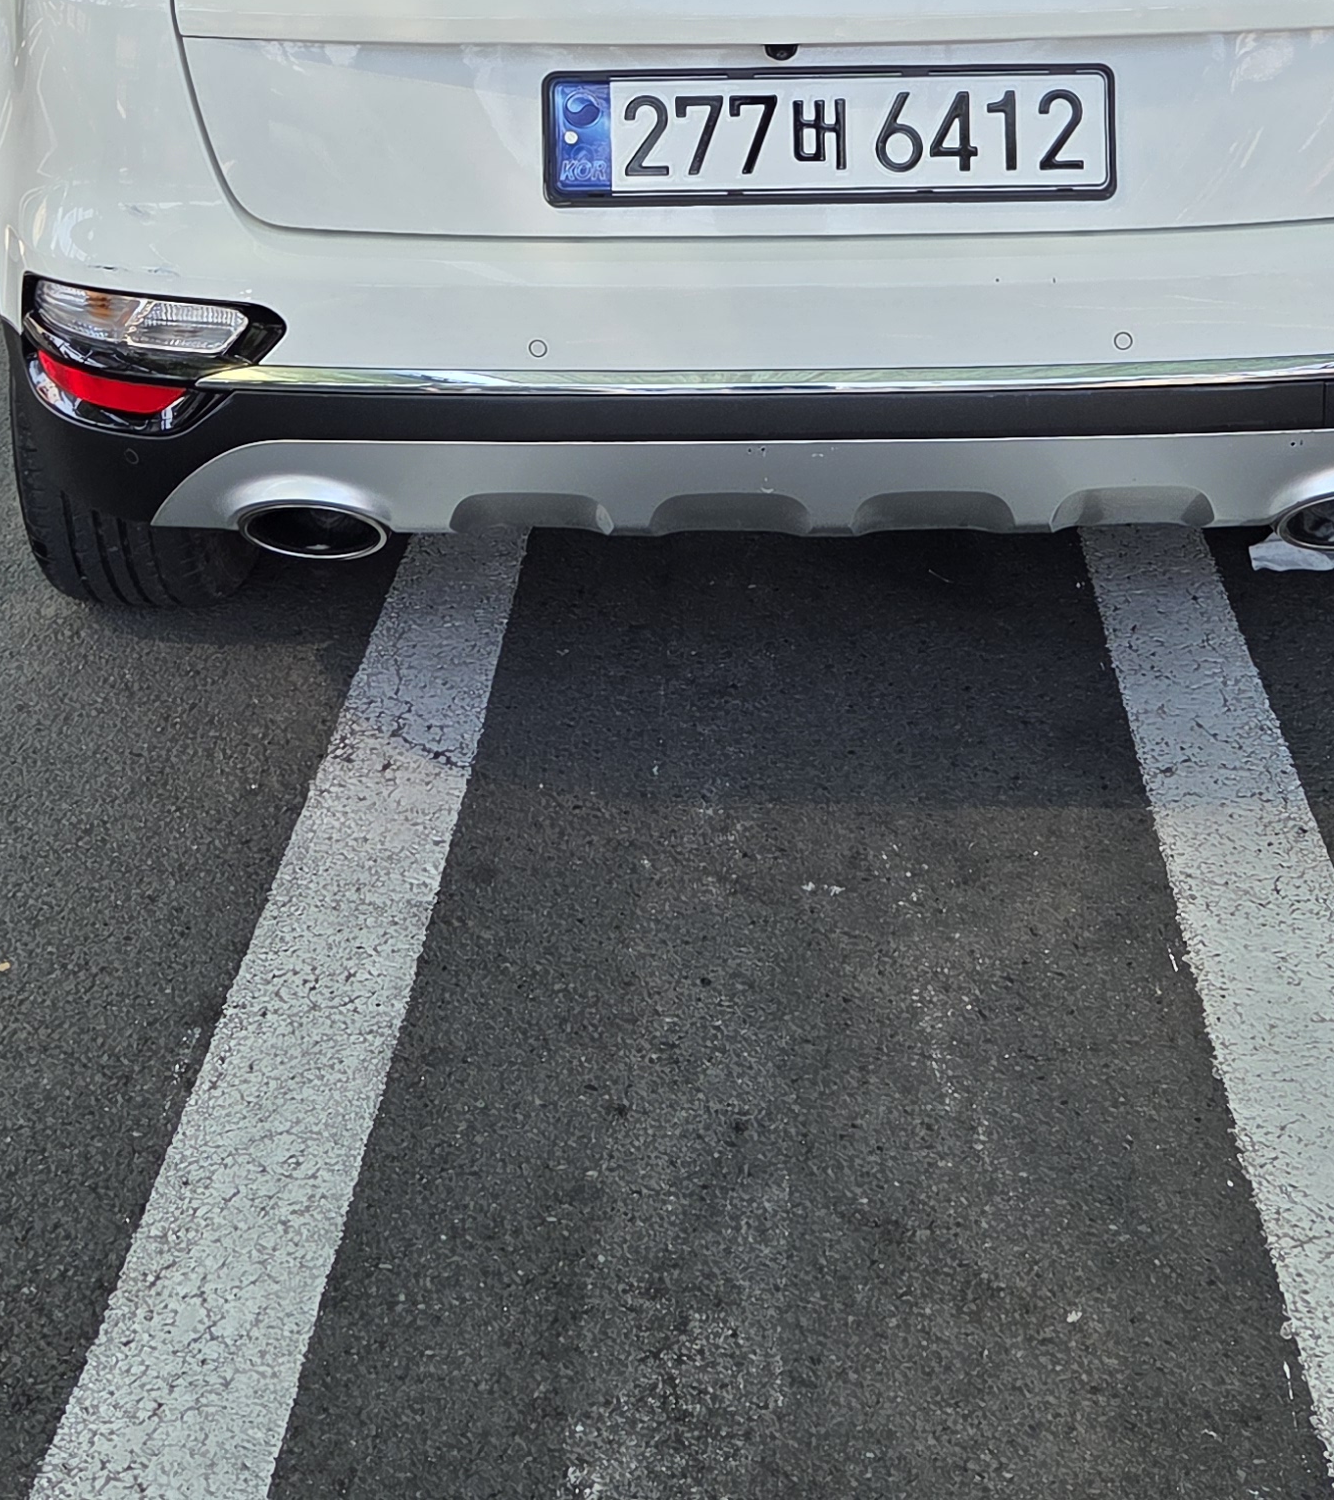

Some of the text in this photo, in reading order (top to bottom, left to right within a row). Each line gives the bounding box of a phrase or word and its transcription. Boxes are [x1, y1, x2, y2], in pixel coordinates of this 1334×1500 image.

[623, 89, 1085, 177] 277버 6412
[559, 160, 606, 181] KOR
